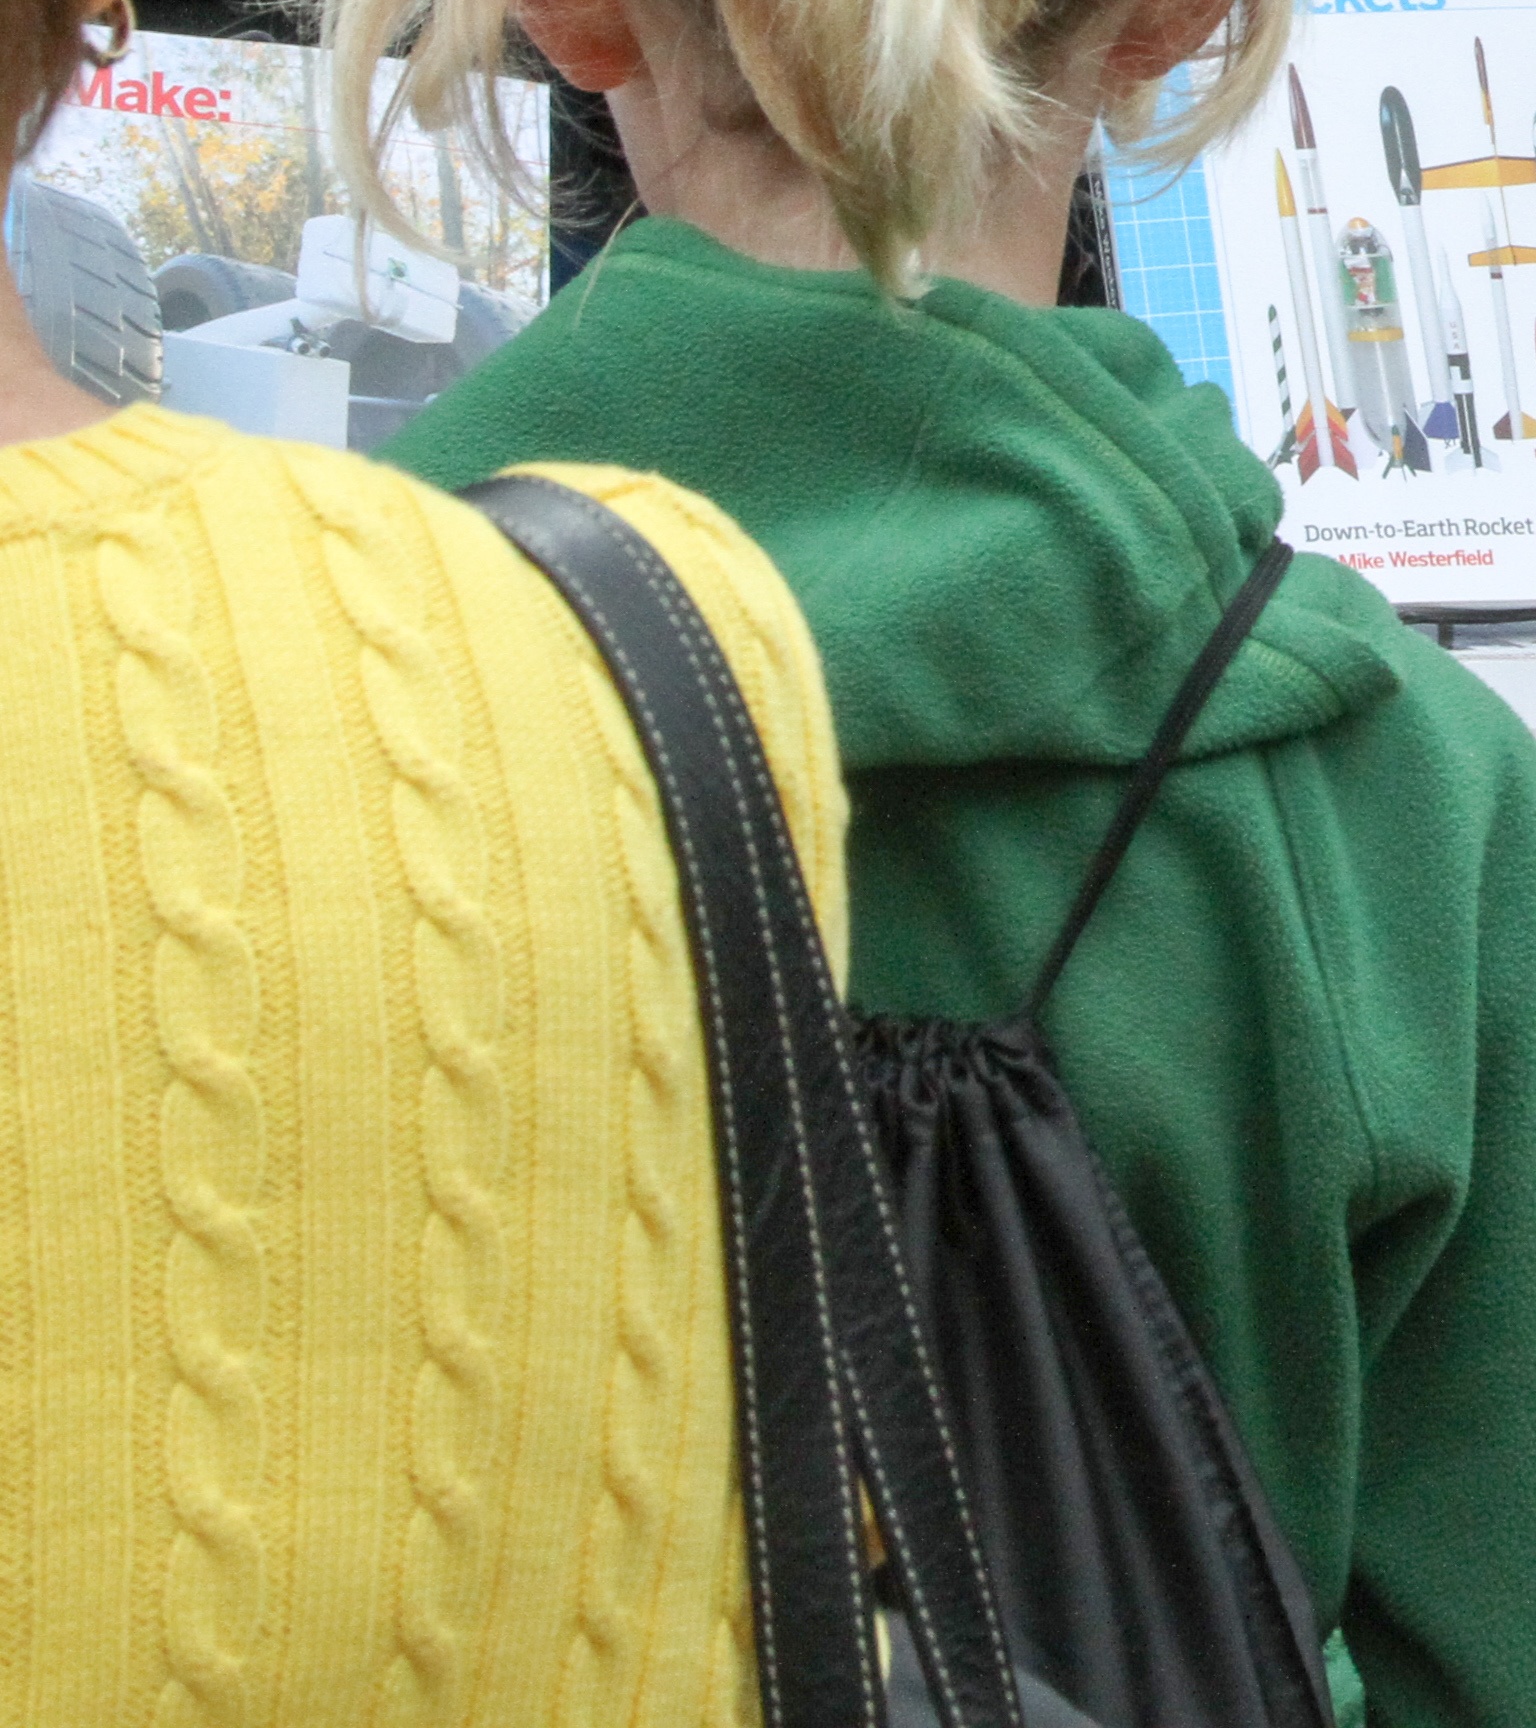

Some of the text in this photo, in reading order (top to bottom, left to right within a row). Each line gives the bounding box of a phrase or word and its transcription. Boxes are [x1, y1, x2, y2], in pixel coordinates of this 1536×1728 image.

[1304, 518, 1461, 543] Down-to-Earth
[1464, 517, 1533, 537] Rocket
[1337, 549, 1494, 570] Mike Westerfield
